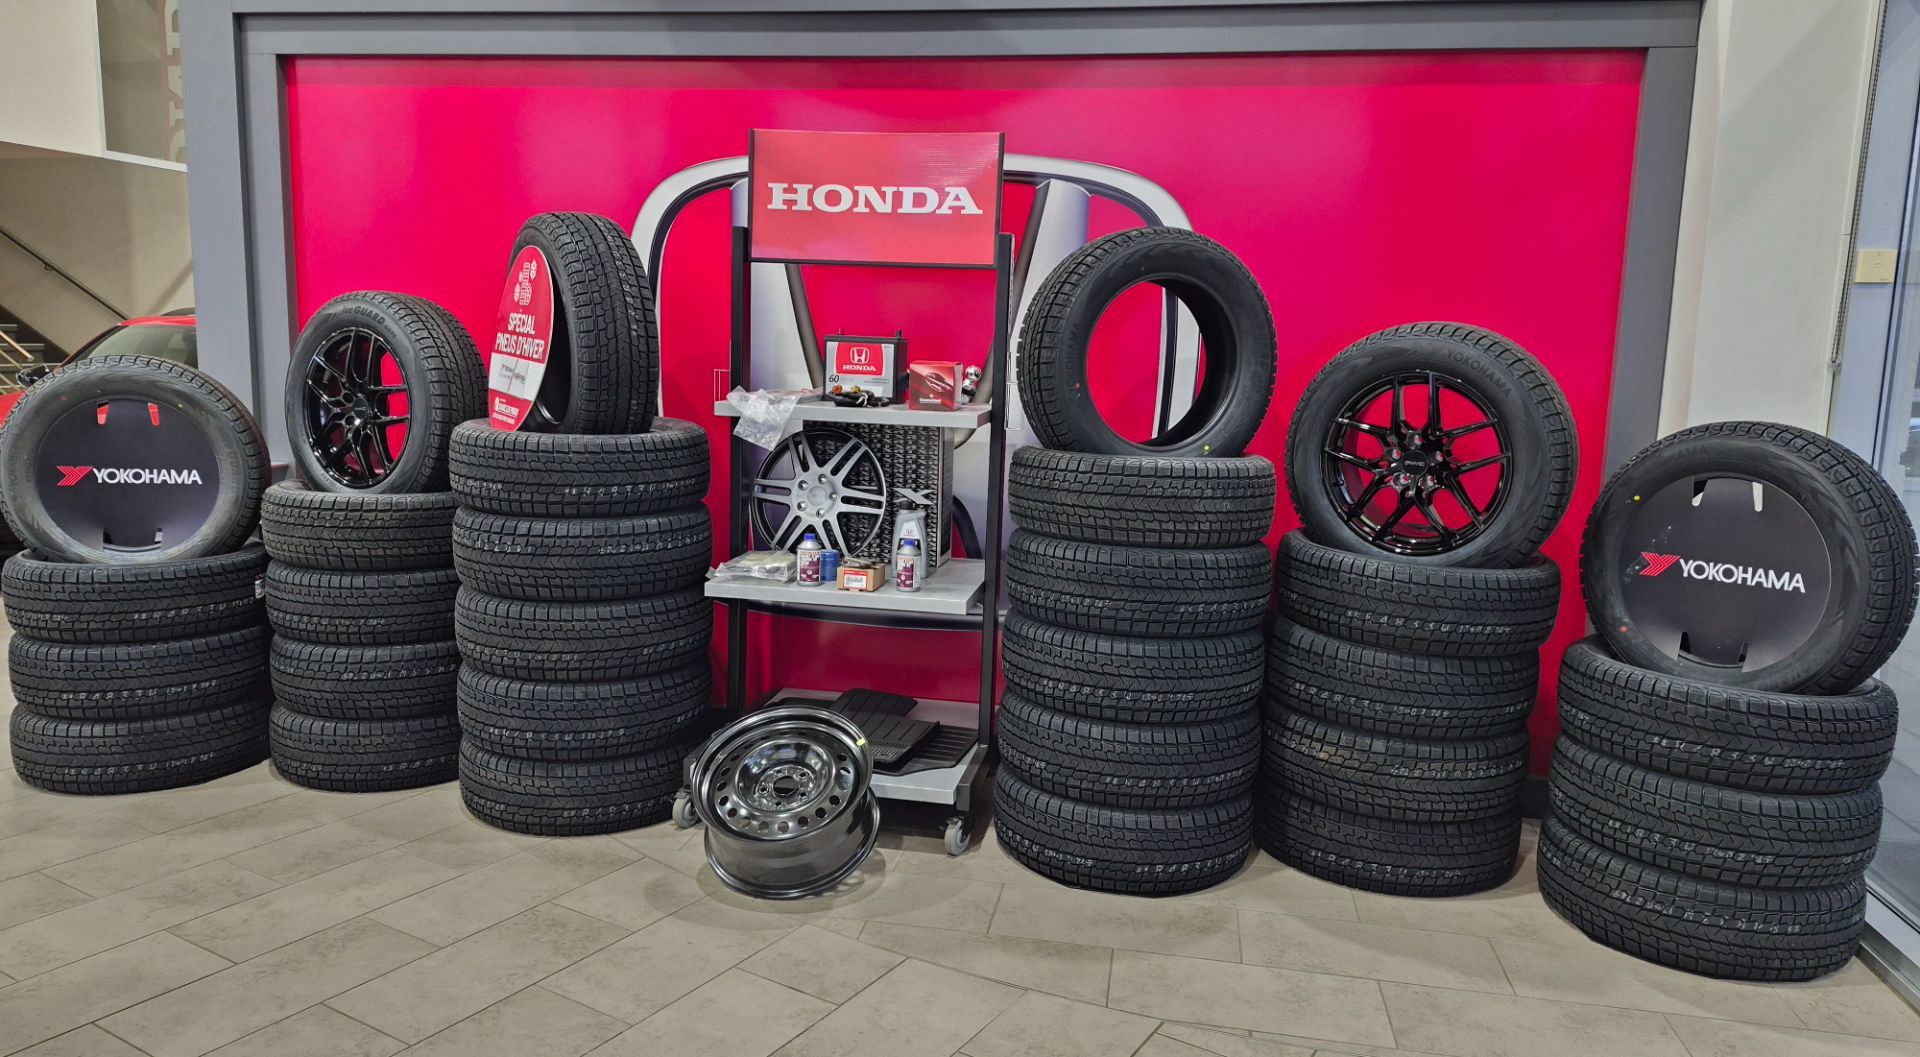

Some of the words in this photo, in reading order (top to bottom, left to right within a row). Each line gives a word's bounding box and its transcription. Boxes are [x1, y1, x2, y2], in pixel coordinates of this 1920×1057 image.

[767, 182, 984, 215] HONDA
[508, 309, 536, 335] SPÉCIAL
[495, 332, 517, 354] PNEUS
[515, 335, 545, 360] D'HIVER
[828, 374, 840, 383] 60
[842, 364, 877, 372] HONDA
[1447, 348, 1512, 399] YOKOHAMA
[93, 468, 203, 485] YOKOHAMA
[1679, 558, 1806, 593] YOKOHAMA
